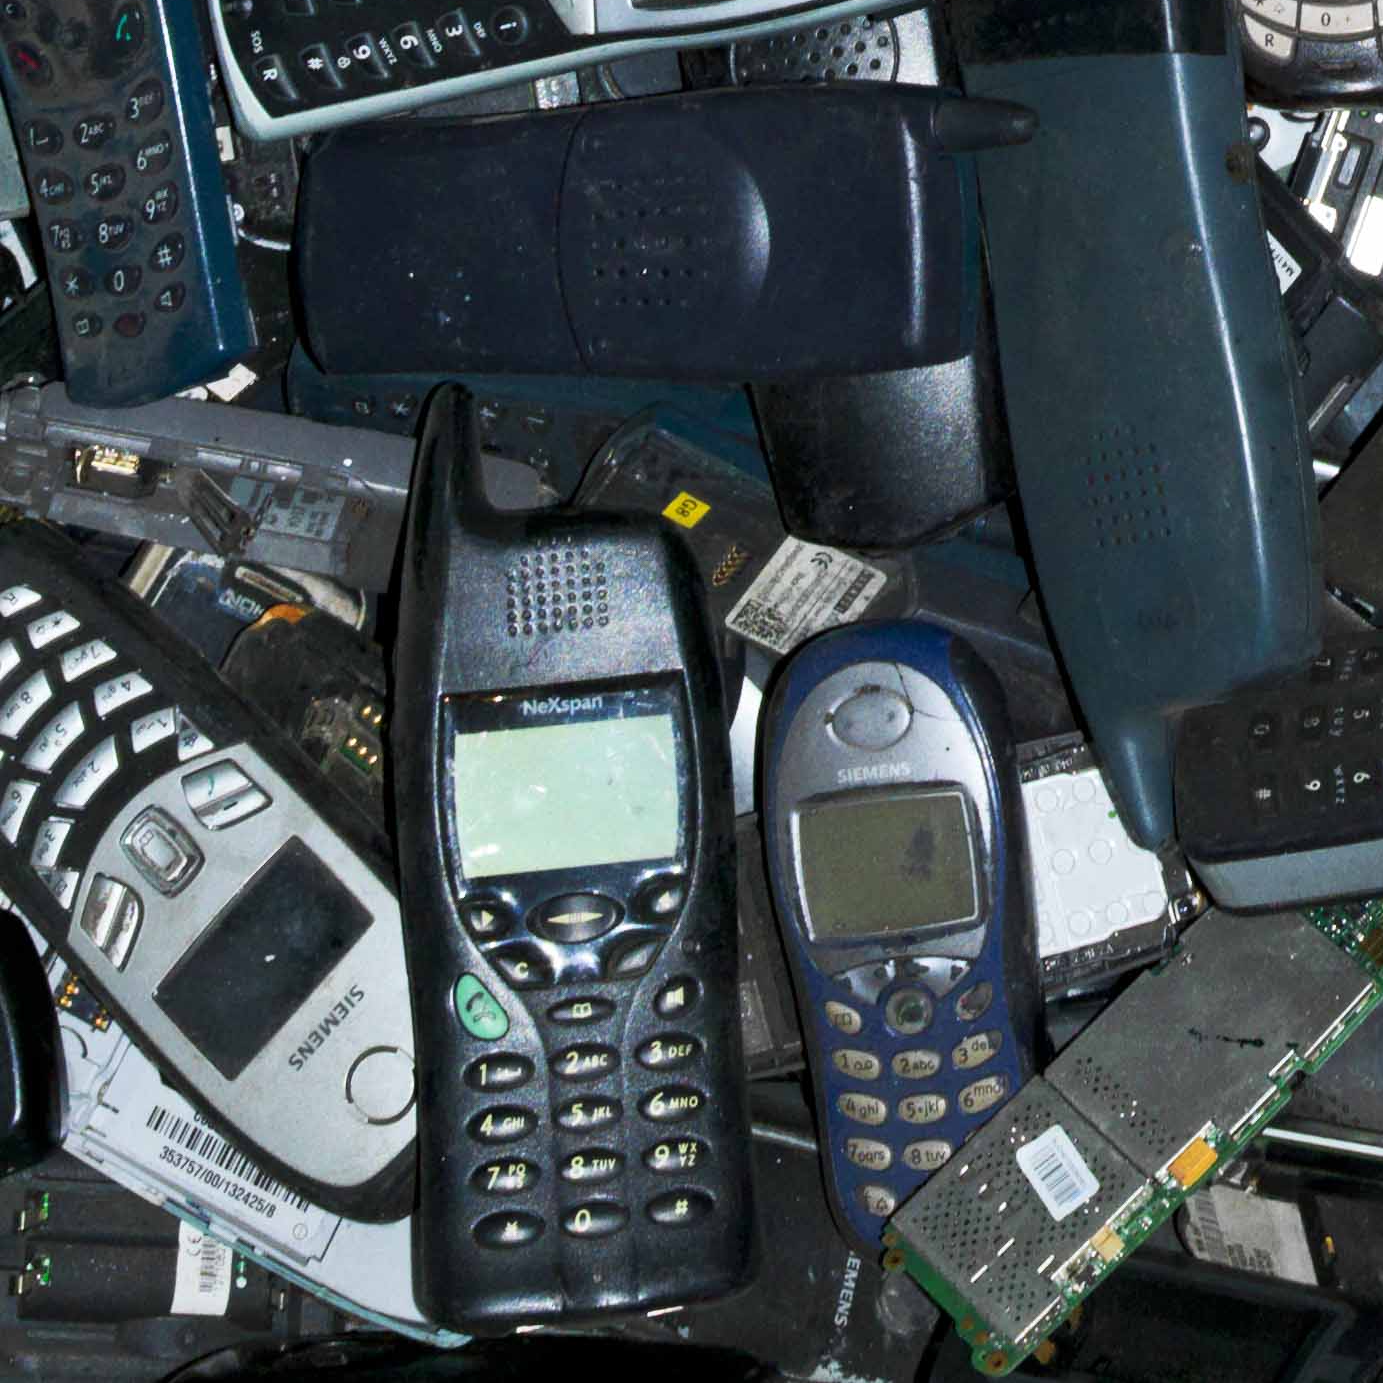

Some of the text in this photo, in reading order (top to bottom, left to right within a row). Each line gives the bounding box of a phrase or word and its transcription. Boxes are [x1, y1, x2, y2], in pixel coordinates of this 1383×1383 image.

[250, 30, 263, 54] SOS
[262, 67, 278, 82] R
[521, 693, 606, 716] NeXspan
[836, 761, 912, 784] SIEMENS
[286, 983, 367, 1072] SIEMENS
[574, 1209, 592, 1232] 0
